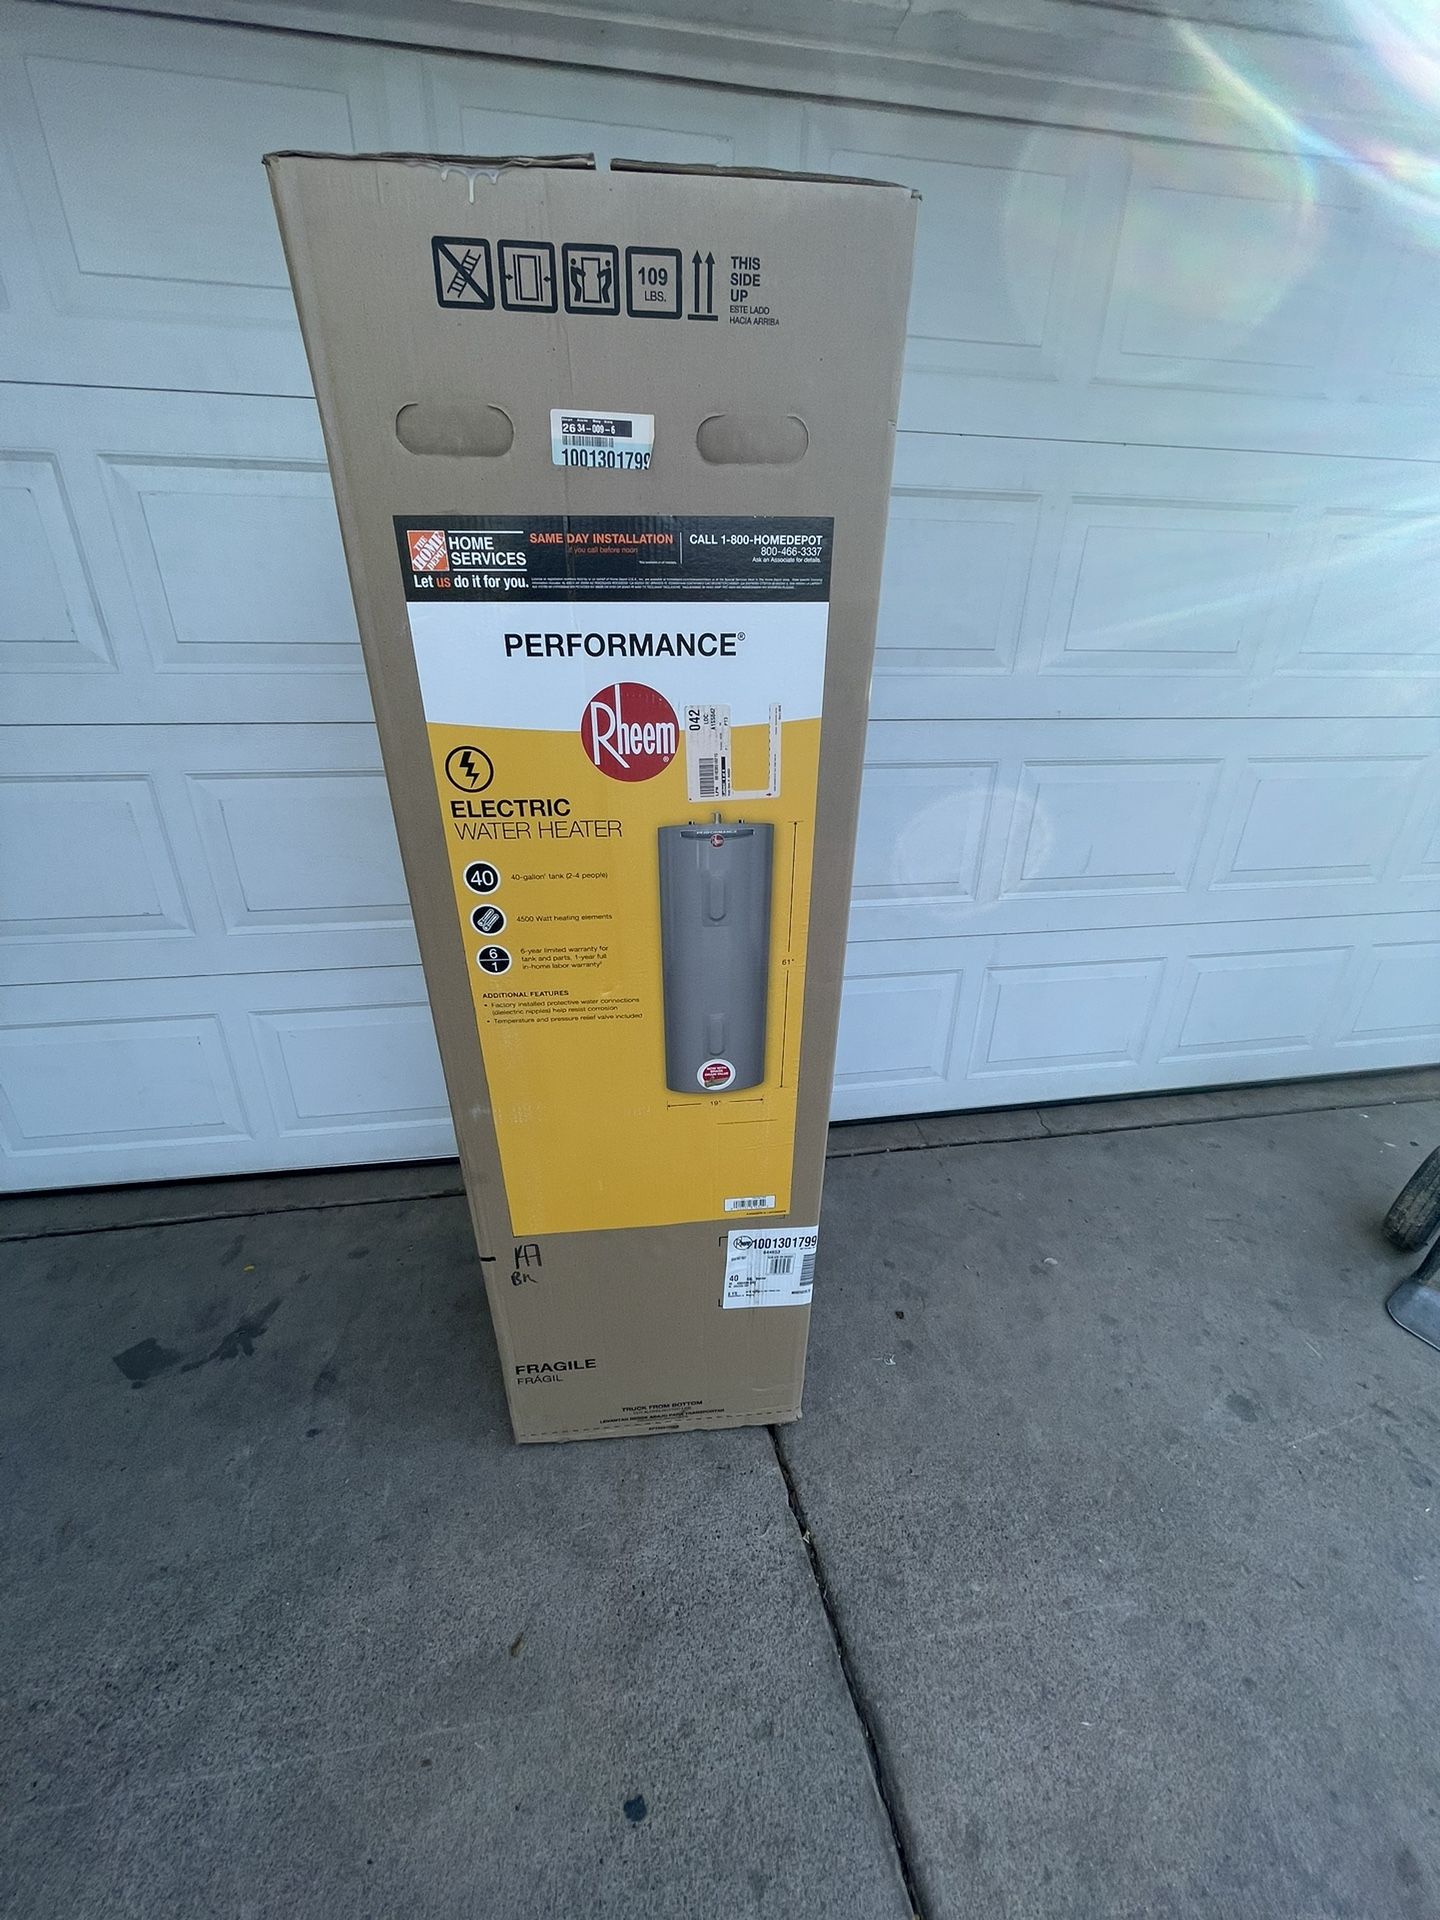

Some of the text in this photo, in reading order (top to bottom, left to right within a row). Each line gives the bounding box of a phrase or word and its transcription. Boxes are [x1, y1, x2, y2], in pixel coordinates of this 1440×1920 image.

[730, 256, 761, 270] THIS
[638, 266, 668, 286] 109
[730, 272, 761, 287] SIDE
[644, 291, 667, 303] LBS.
[730, 289, 748, 302] UP
[729, 305, 770, 315] ESTE LADO
[729, 316, 780, 326] HACIA ARRIBA
[561, 448, 651, 470] 1001301799
[413, 535, 427, 551] THE
[448, 536, 494, 550] HOME
[529, 532, 674, 544] SAME DAY INSTALLATION
[689, 534, 823, 546] CALL 1-800-HOMEDEPOT
[412, 531, 446, 570] HOME
[761, 547, 822, 557] 800-466-3337
[451, 552, 527, 566] SERVICES
[413, 574, 529, 591] Let us do it for you.
[590, 684, 676, 768] Rheem
[689, 709, 701, 731] 042
[450, 798, 571, 818] ELECTRIC
[454, 820, 623, 840] WATER HEATER
[470, 870, 495, 886] 40
[565, 872, 580, 880] (2-4
[581, 872, 608, 880] people)
[553, 915, 579, 923] heating
[489, 949, 498, 960] 6
[491, 962, 499, 972] 1
[482, 990, 569, 999] ADDITIONAL FEATURES
[752, 1235, 817, 1249] 1001301799
[729, 1274, 739, 1282] 40
[515, 1358, 597, 1375] FRAGILE
[672, 1400, 703, 1408] BOTTOM
